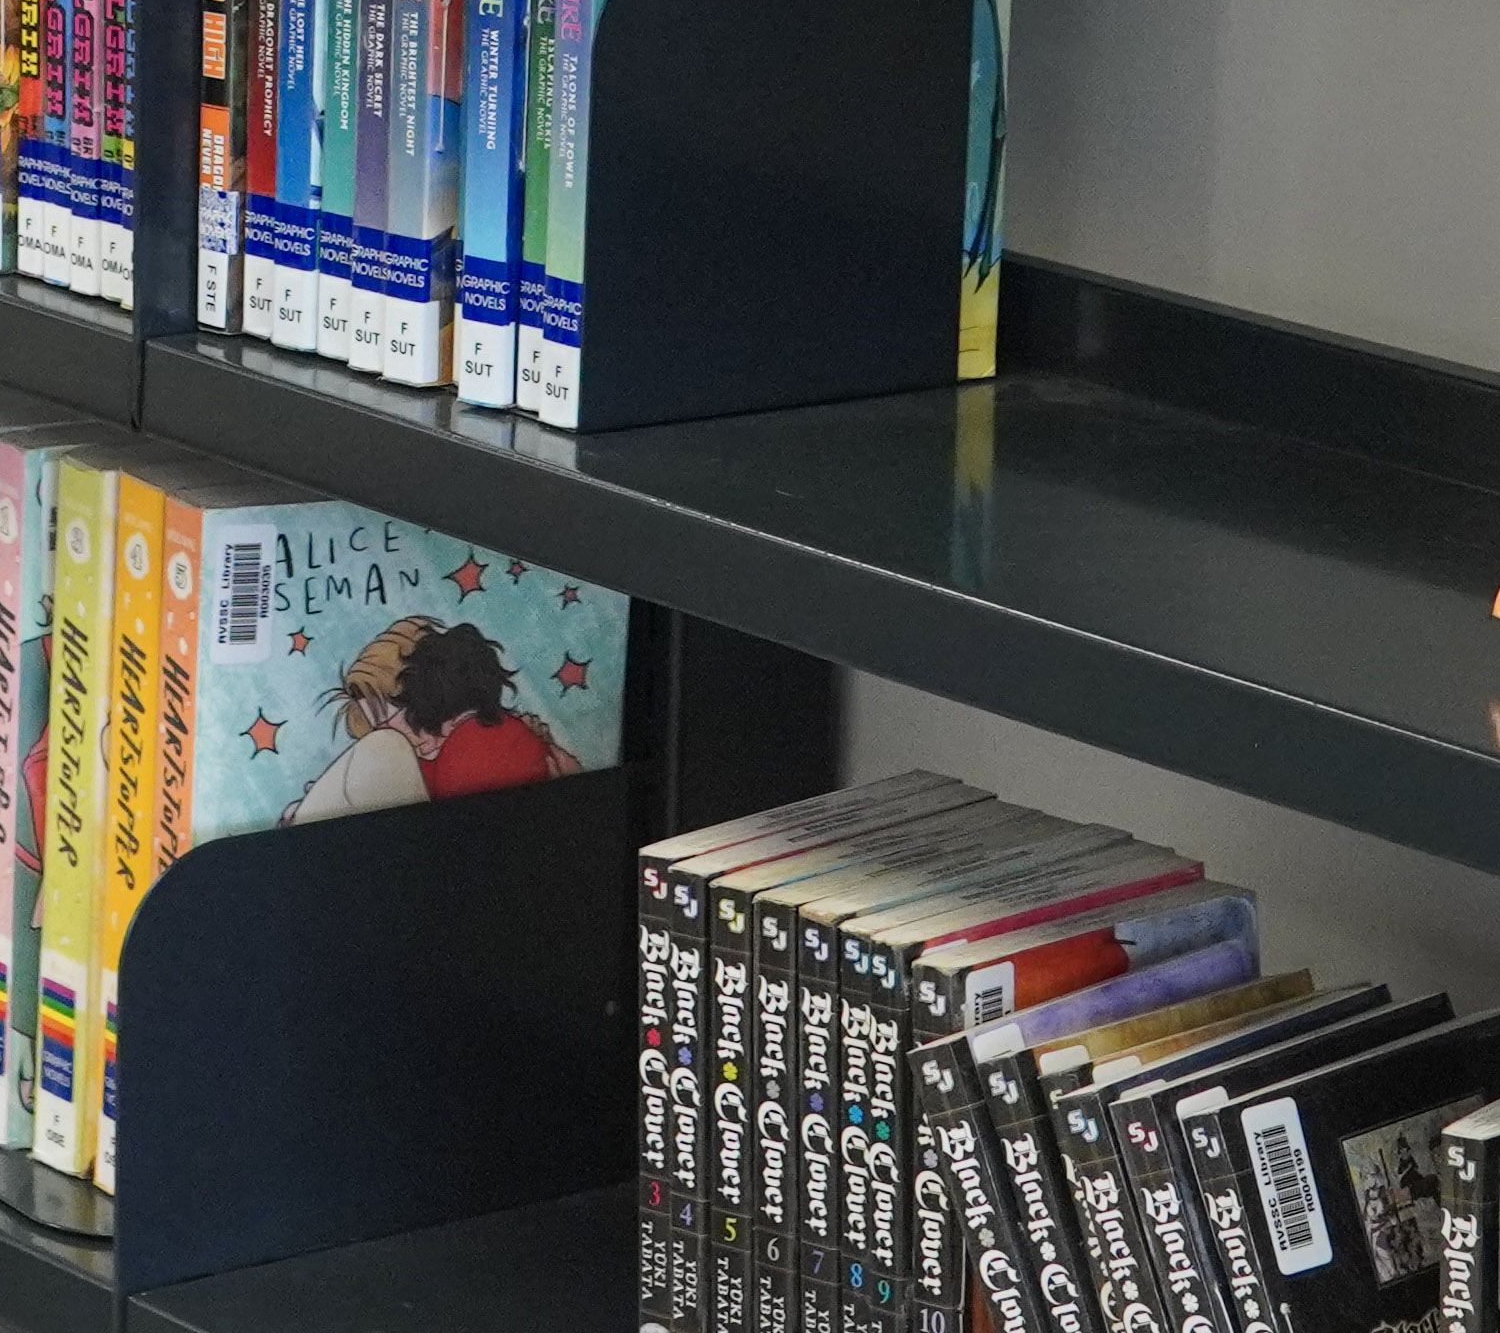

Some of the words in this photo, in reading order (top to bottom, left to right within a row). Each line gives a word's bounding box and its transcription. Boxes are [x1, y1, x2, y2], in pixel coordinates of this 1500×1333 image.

[202, 11, 227, 80] HIGH
[462, 275, 510, 296] GRAPHIC
[464, 293, 507, 312] NOVELS
[276, 520, 401, 579] ALICE
[274, 563, 419, 615] SEMAN
[58, 616, 89, 869] HEARTSTOPPER
[639, 925, 671, 1025] Black
[715, 957, 749, 1068] Black
[638, 1048, 671, 1170] Clover
[715, 1083, 750, 1206] Clover
[1254, 1131, 1273, 1185] Library
[649, 1181, 661, 1206] 3
[724, 1217, 738, 1242] 5
[1269, 1198, 1288, 1252] RVSSC
